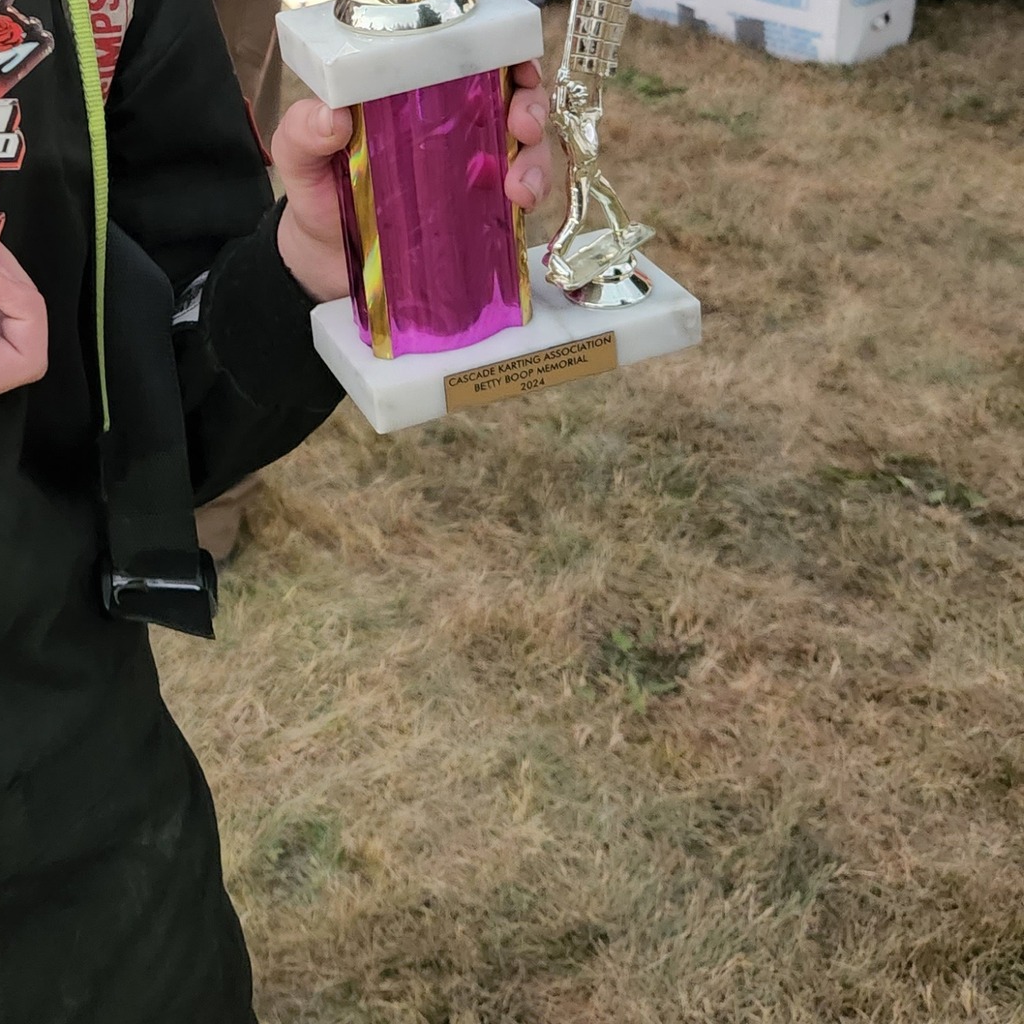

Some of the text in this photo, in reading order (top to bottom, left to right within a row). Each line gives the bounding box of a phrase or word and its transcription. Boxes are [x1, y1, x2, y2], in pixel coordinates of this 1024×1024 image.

[448, 335, 613, 388] CASCADE KARTING ASSOCIATION
[474, 355, 589, 393] BETTY BOOP MEMORIAL
[520, 377, 546, 392] 2024
